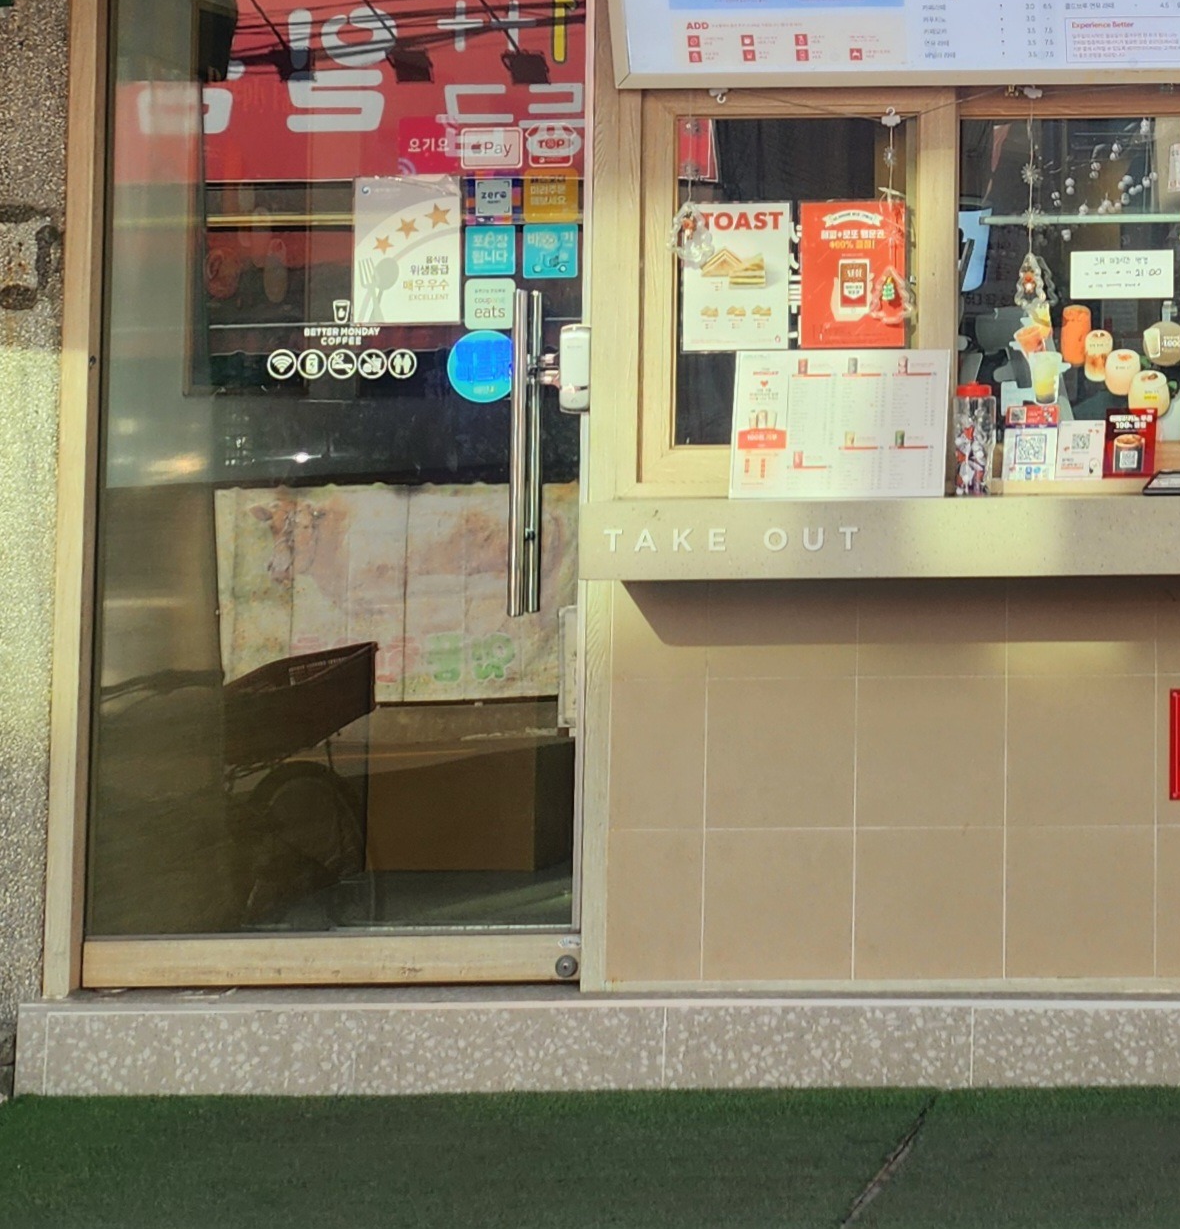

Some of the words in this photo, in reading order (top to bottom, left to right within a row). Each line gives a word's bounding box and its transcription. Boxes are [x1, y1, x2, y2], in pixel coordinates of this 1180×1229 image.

[686, 22, 709, 30] ADD
[1072, 21, 1110, 30] Experience
[407, 138, 450, 153] 요기요
[484, 141, 513, 157] Pay
[537, 137, 566, 149] TOP
[701, 211, 784, 231] TOAST
[410, 264, 449, 276] 위생등급
[403, 279, 426, 291] 매우
[427, 279, 449, 290] 우수
[474, 306, 505, 318] eats
[304, 328, 339, 337] BETTER
[340, 326, 380, 336] MONDAY
[321, 336, 361, 345] COFFEE
[604, 528, 726, 552] TAKE
[763, 526, 858, 551] OUT
